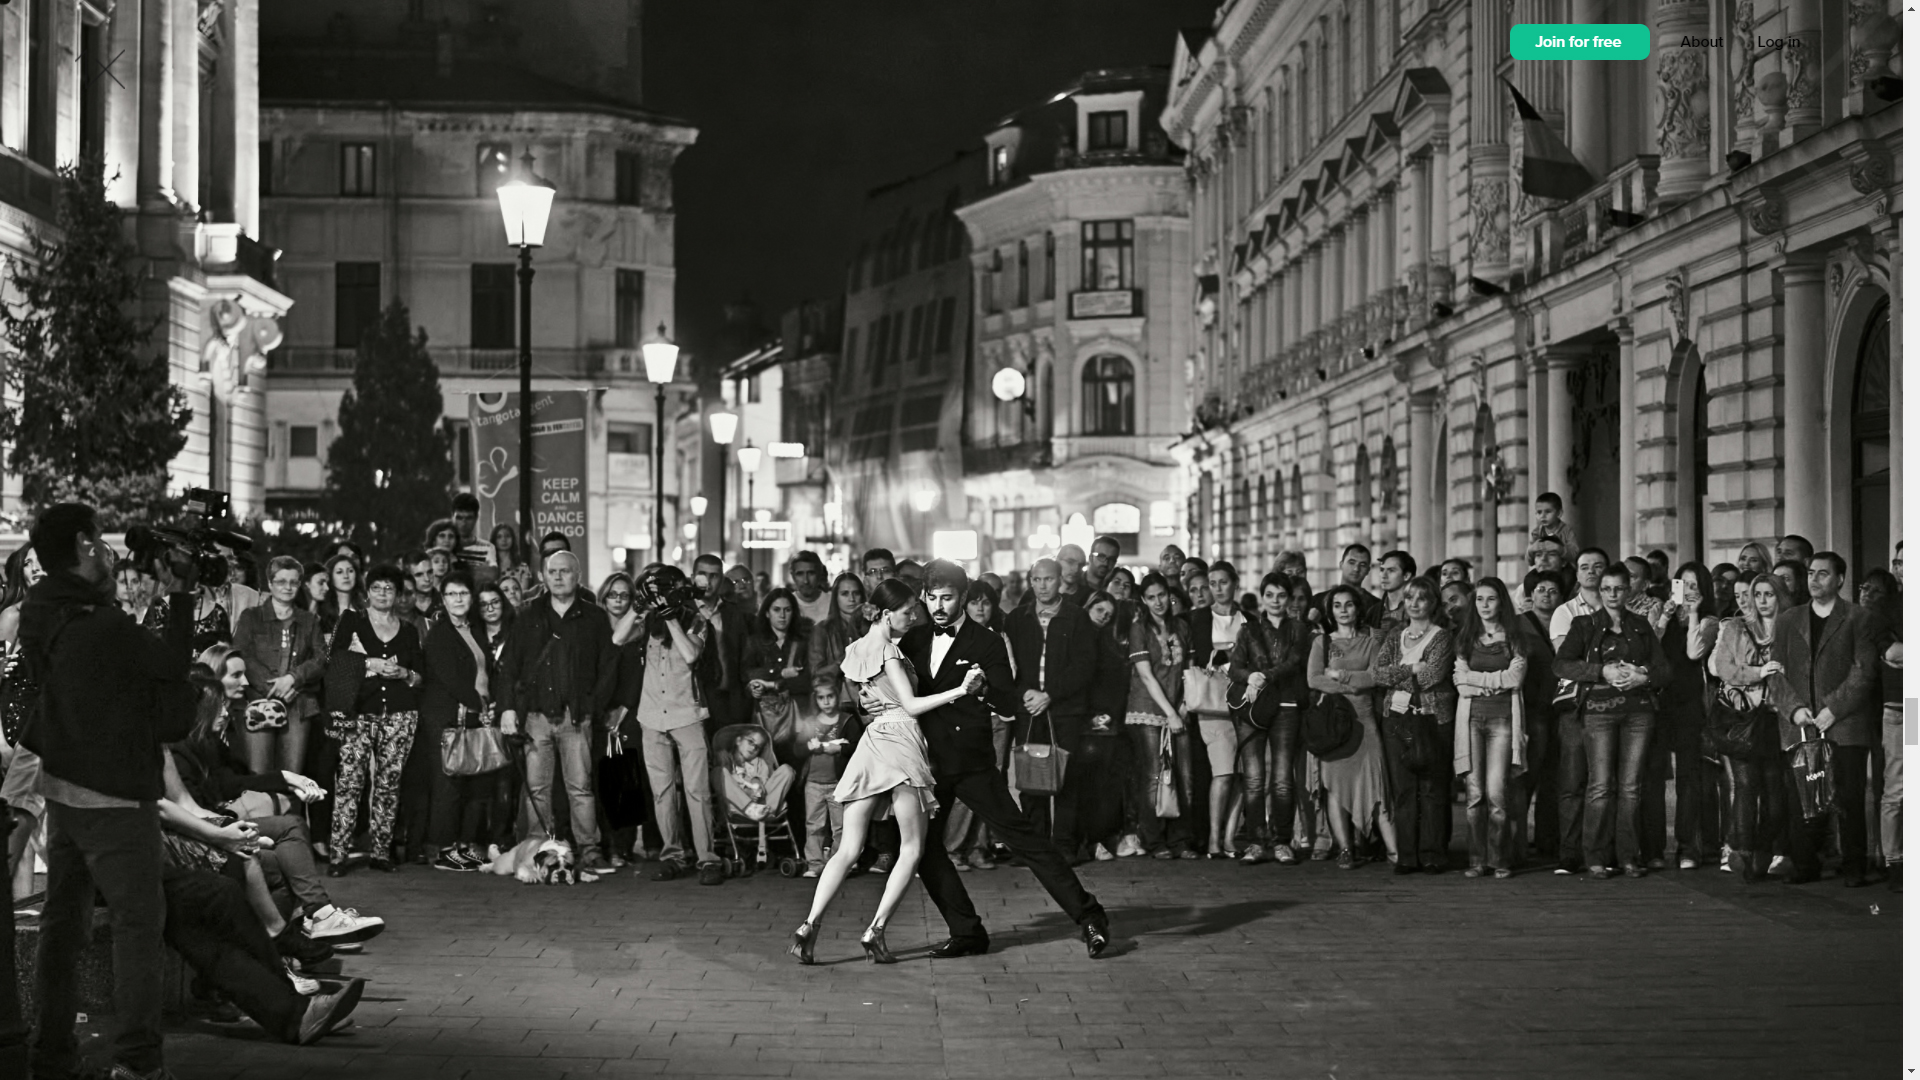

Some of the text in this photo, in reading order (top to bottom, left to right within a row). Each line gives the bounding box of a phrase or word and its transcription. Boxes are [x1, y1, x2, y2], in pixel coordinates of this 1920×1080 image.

[477, 395, 555, 426] tangotagent
[542, 478, 579, 490] KEEP
[541, 492, 580, 504] CALM
[537, 511, 584, 524] DANCE
[537, 525, 585, 537] TANGO
